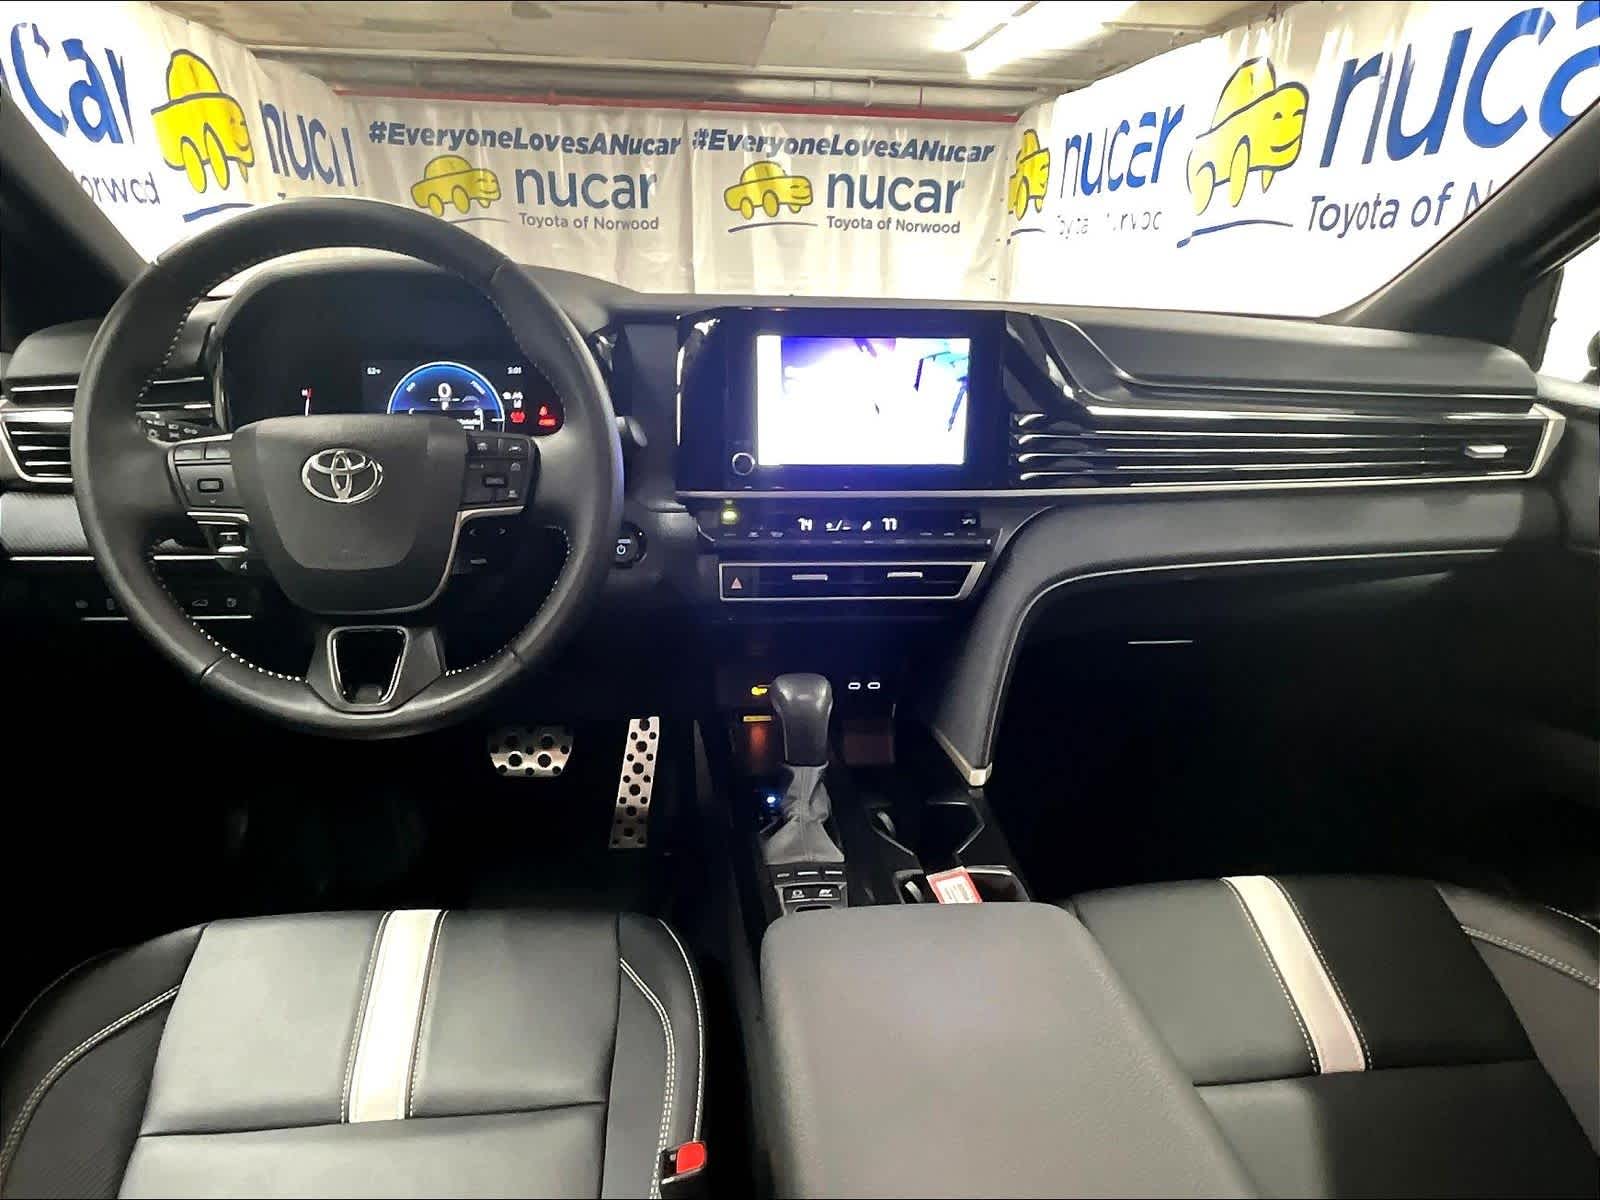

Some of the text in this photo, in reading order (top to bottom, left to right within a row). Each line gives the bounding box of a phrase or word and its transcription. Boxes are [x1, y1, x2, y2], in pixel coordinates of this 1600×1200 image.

[368, 120, 682, 156] #EveryoneLovesANucar
[692, 127, 995, 163] #EveryoneLovesANucar
[1060, 103, 1185, 199] nucar
[514, 167, 657, 209] nucar
[826, 173, 965, 213] nucar
[519, 212, 660, 231] Toyota of Norwood
[826, 215, 961, 234] Toyota of Norwood
[1308, 191, 1400, 239] Toyota
[1410, 181, 1455, 228] of
